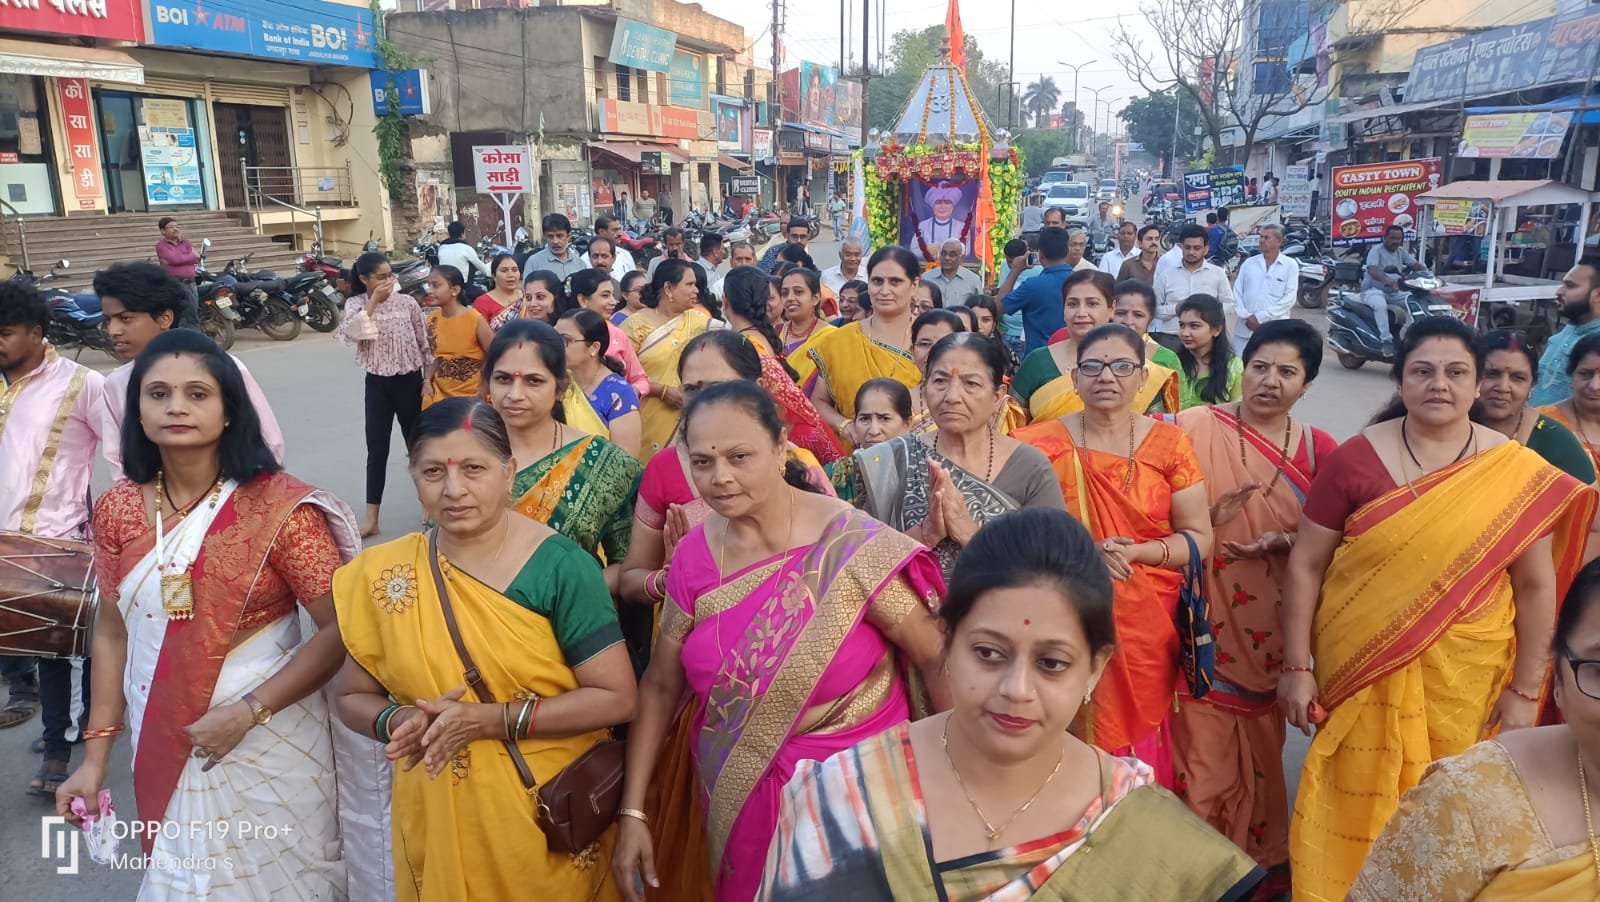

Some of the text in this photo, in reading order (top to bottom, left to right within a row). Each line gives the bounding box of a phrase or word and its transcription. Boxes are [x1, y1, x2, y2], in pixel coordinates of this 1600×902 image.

[156, 5, 189, 26] BOI
[263, 33, 310, 47] Bank of India
[311, 23, 348, 51] BOI
[626, 44, 670, 66] DENTAL CLINIC
[374, 88, 399, 103] BI
[481, 148, 521, 164] कोसा
[486, 167, 520, 185] साड़ी
[1342, 167, 1420, 183] TASTY TOWN
[1335, 182, 1427, 198] SOUTH INDIAN RESTAURENT
